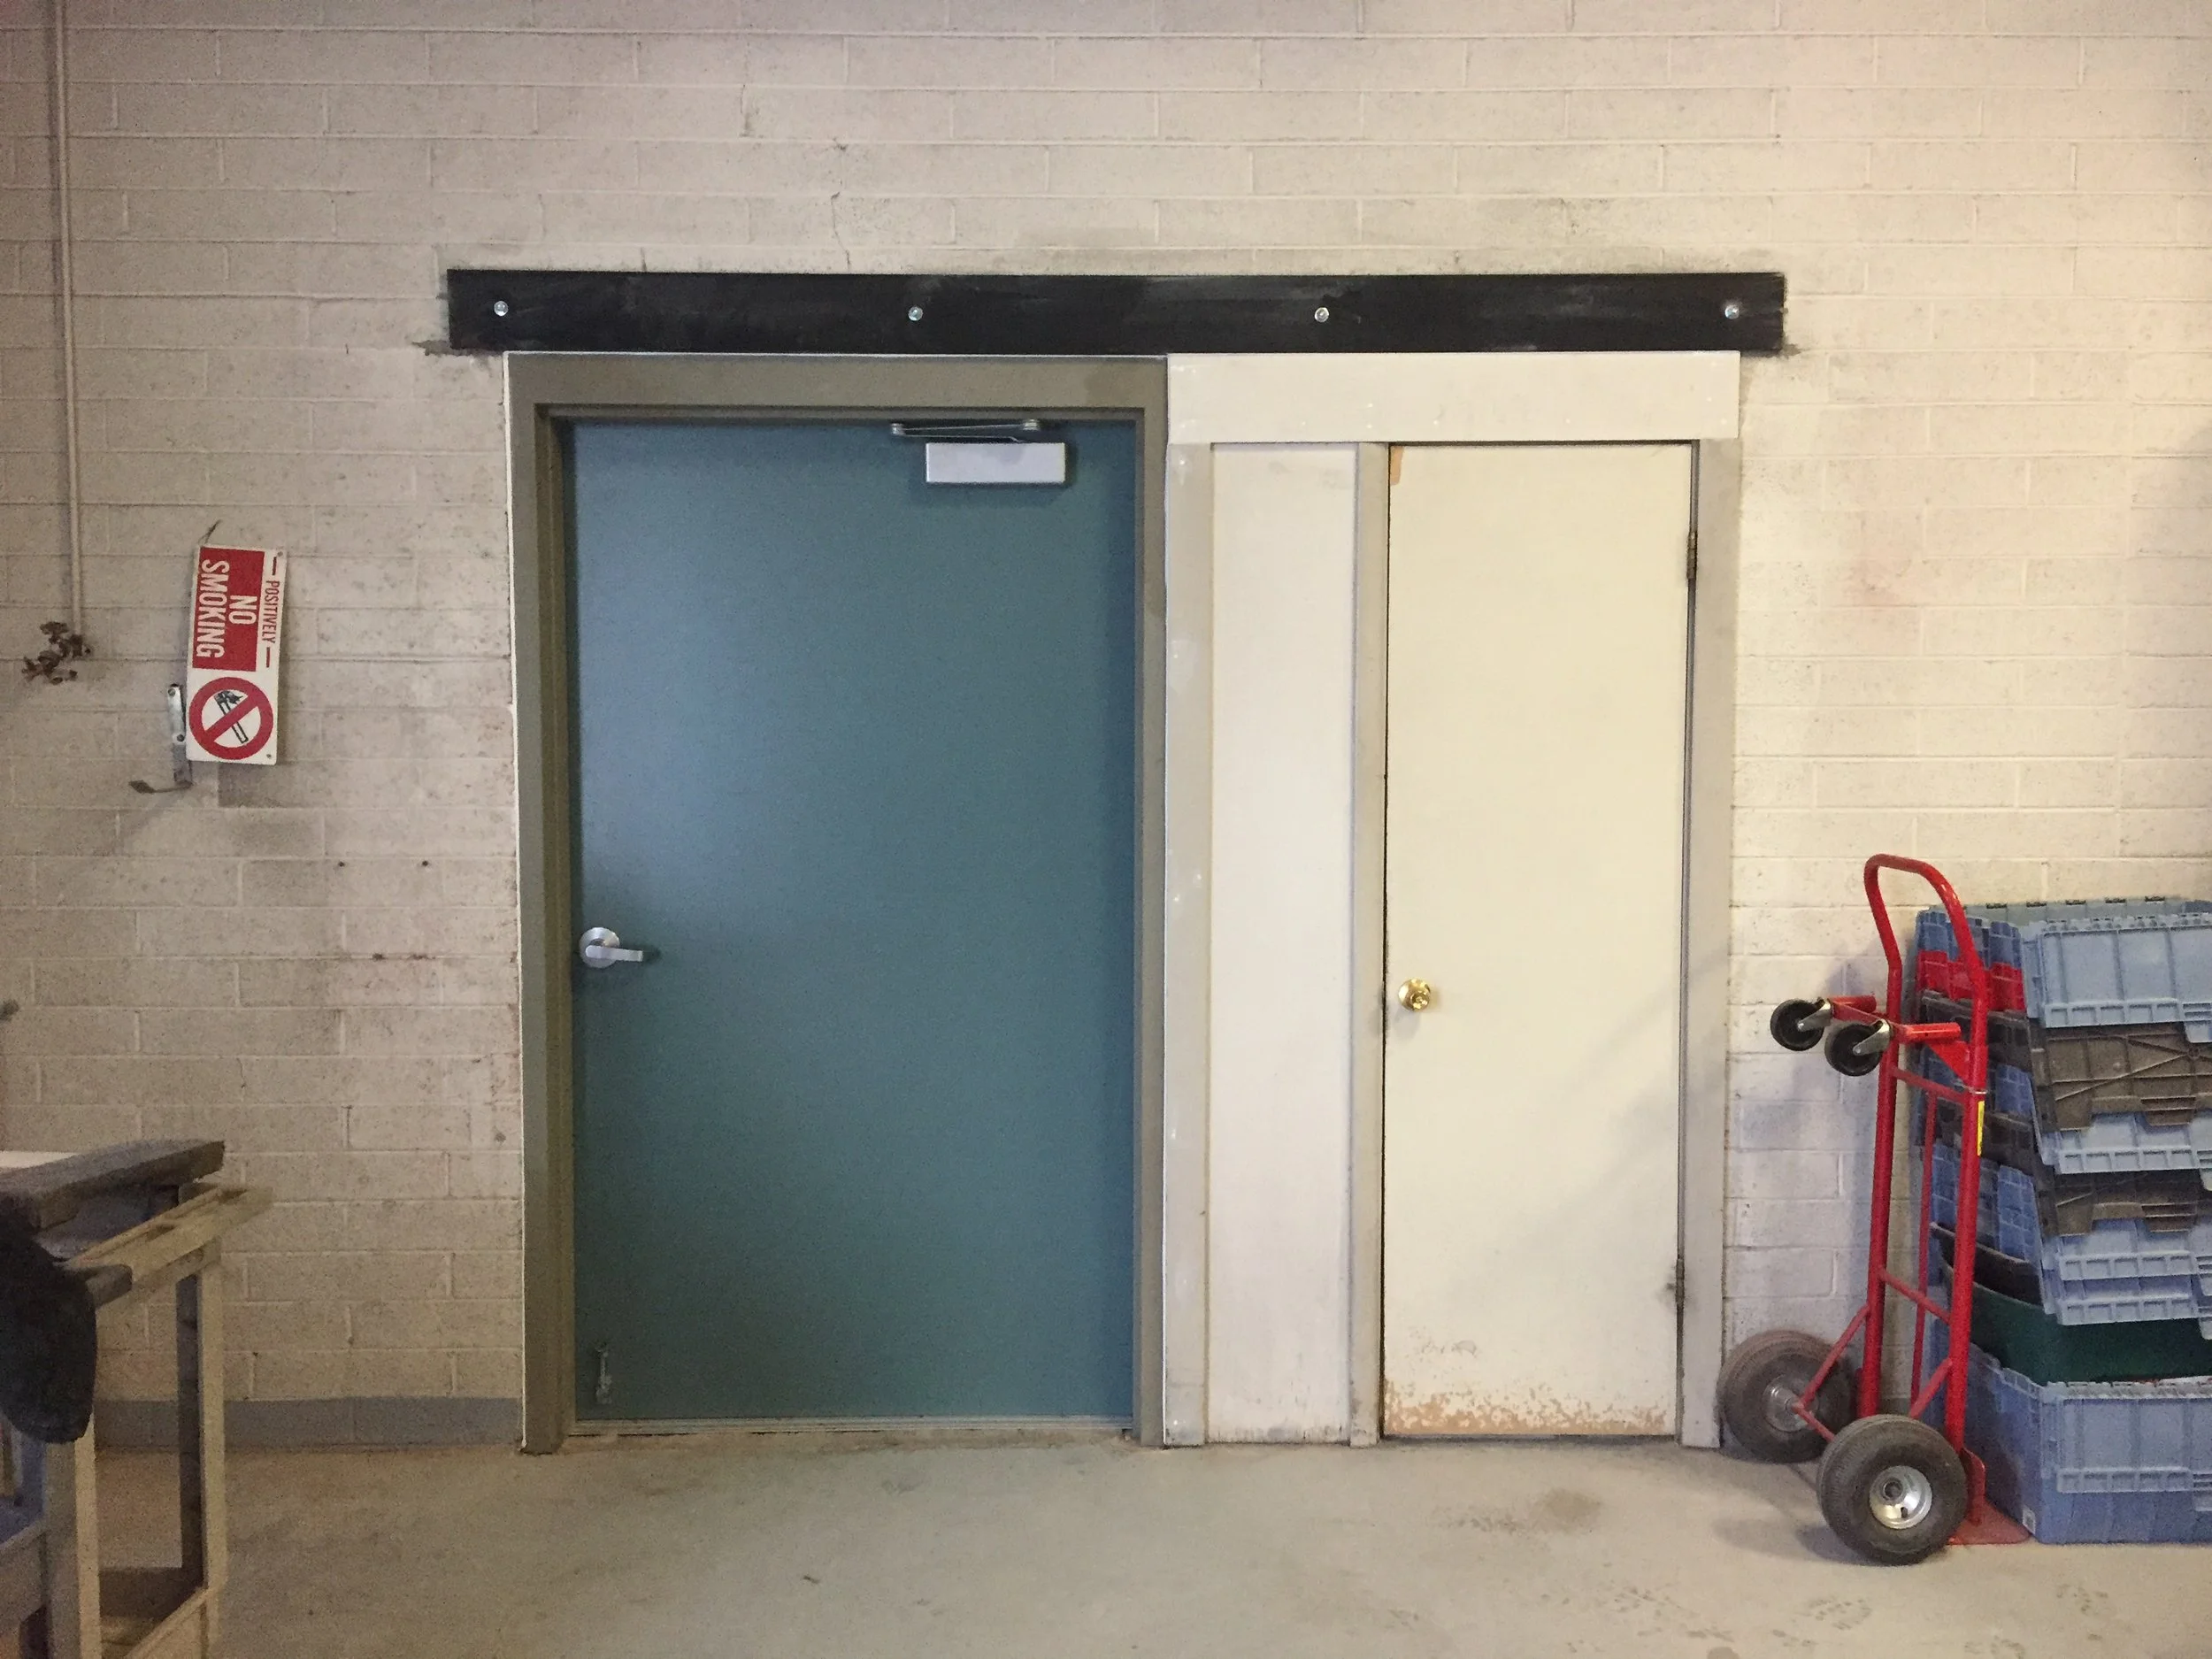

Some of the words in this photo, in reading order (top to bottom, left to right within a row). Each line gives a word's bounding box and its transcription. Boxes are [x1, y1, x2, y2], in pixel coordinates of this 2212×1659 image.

[196, 559, 230, 658] SMOKING
[228, 595, 257, 625] NO
[261, 580, 280, 644] POSITIVELY
